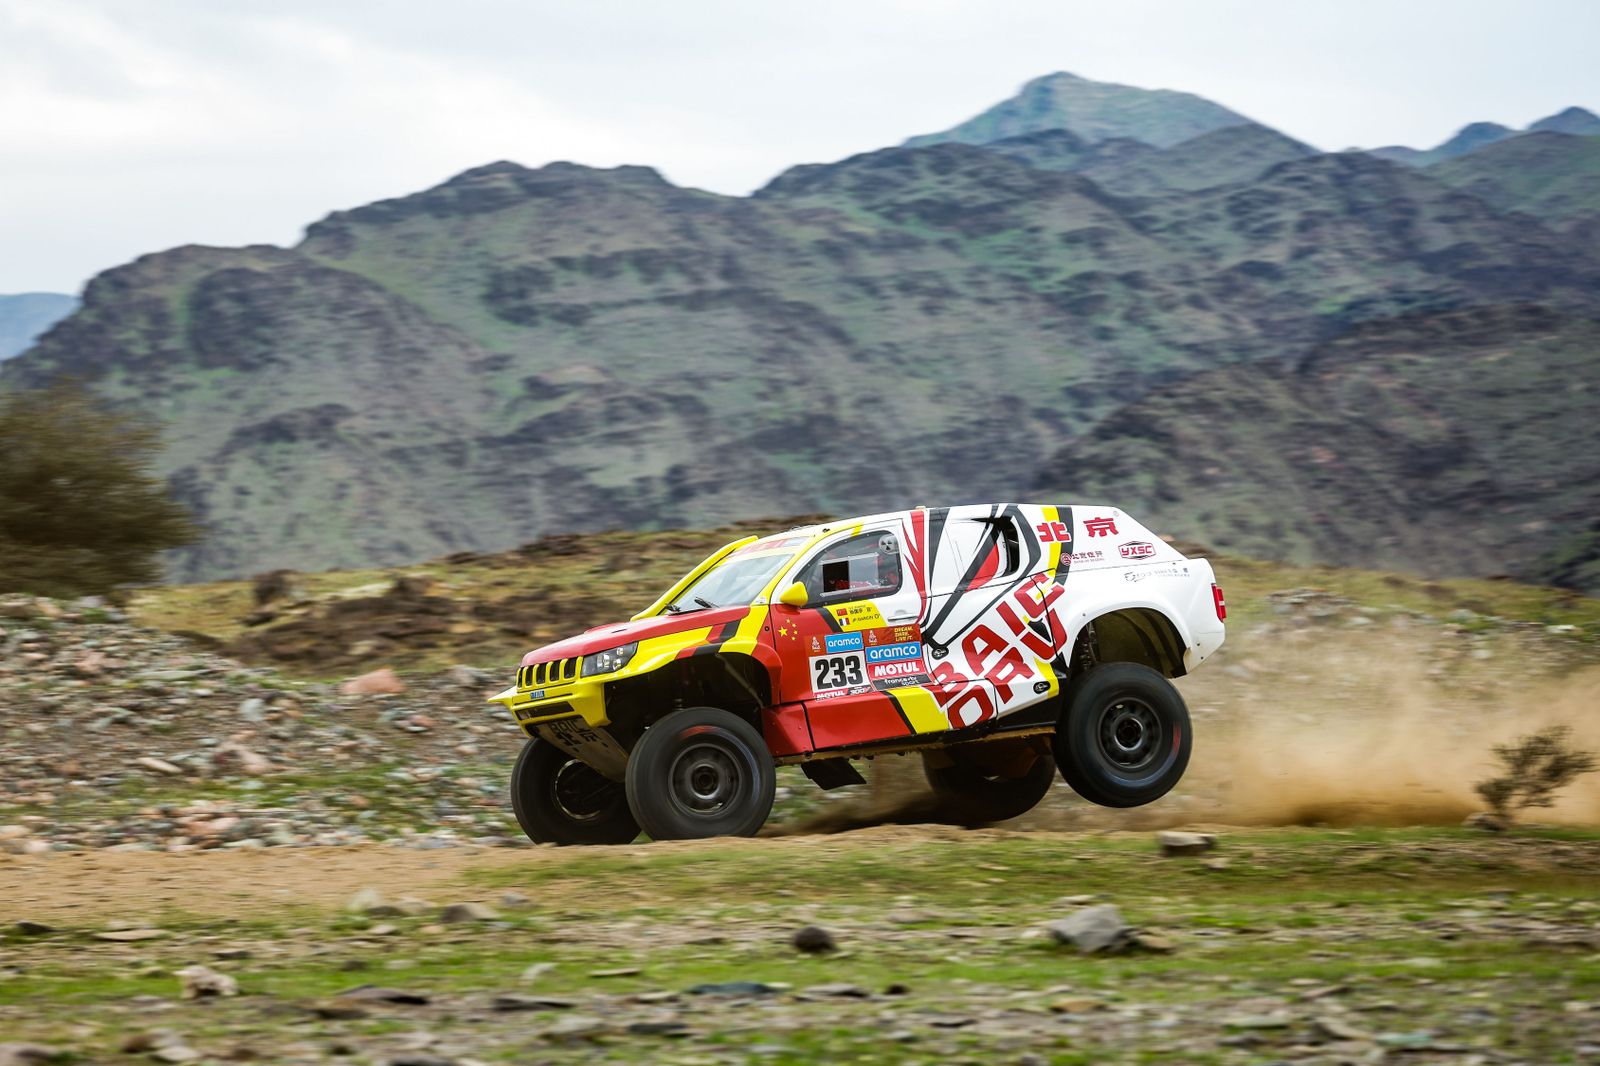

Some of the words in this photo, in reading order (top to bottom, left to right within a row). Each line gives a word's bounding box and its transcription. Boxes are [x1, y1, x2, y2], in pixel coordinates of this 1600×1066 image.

[1121, 545, 1153, 556] YXSC
[828, 636, 860, 647] aramco
[922, 573, 1065, 708] BAIC
[870, 645, 917, 659] aramco
[815, 656, 863, 690] 233
[874, 661, 920, 677] MOTUL
[948, 608, 1067, 729] ORV
[815, 690, 846, 701] MOTUL
